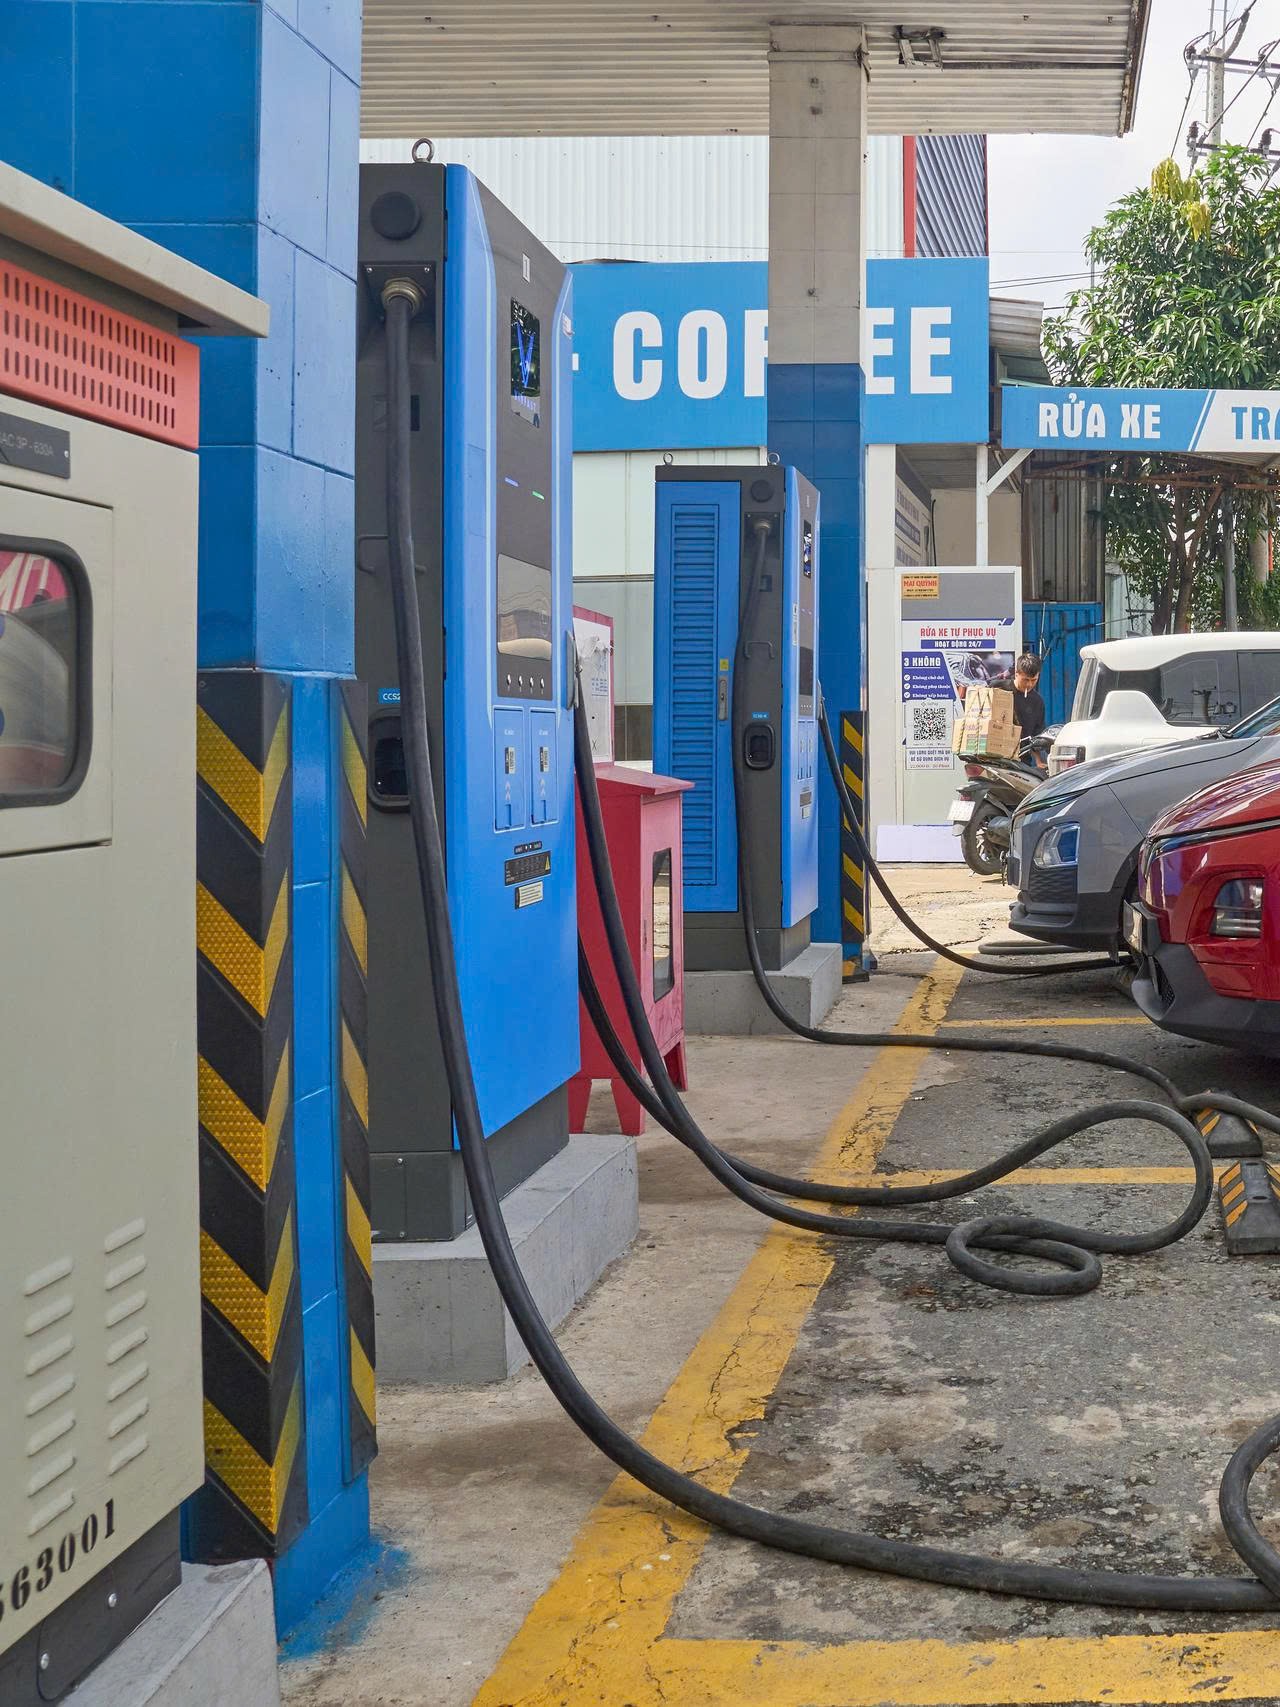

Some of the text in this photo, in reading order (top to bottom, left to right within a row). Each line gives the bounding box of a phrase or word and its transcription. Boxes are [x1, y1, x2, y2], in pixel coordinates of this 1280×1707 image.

[613, 307, 952, 400] COFEE
[1039, 392, 1161, 439] RỬA XE
[920, 626, 936, 637] RỬA
[938, 628, 948, 637] XE
[962, 628, 984, 638] PHỤC
[985, 628, 996, 638] VỤ
[968, 640, 982, 648] 24/7
[903, 655, 941, 667] 3 KHÔNG
